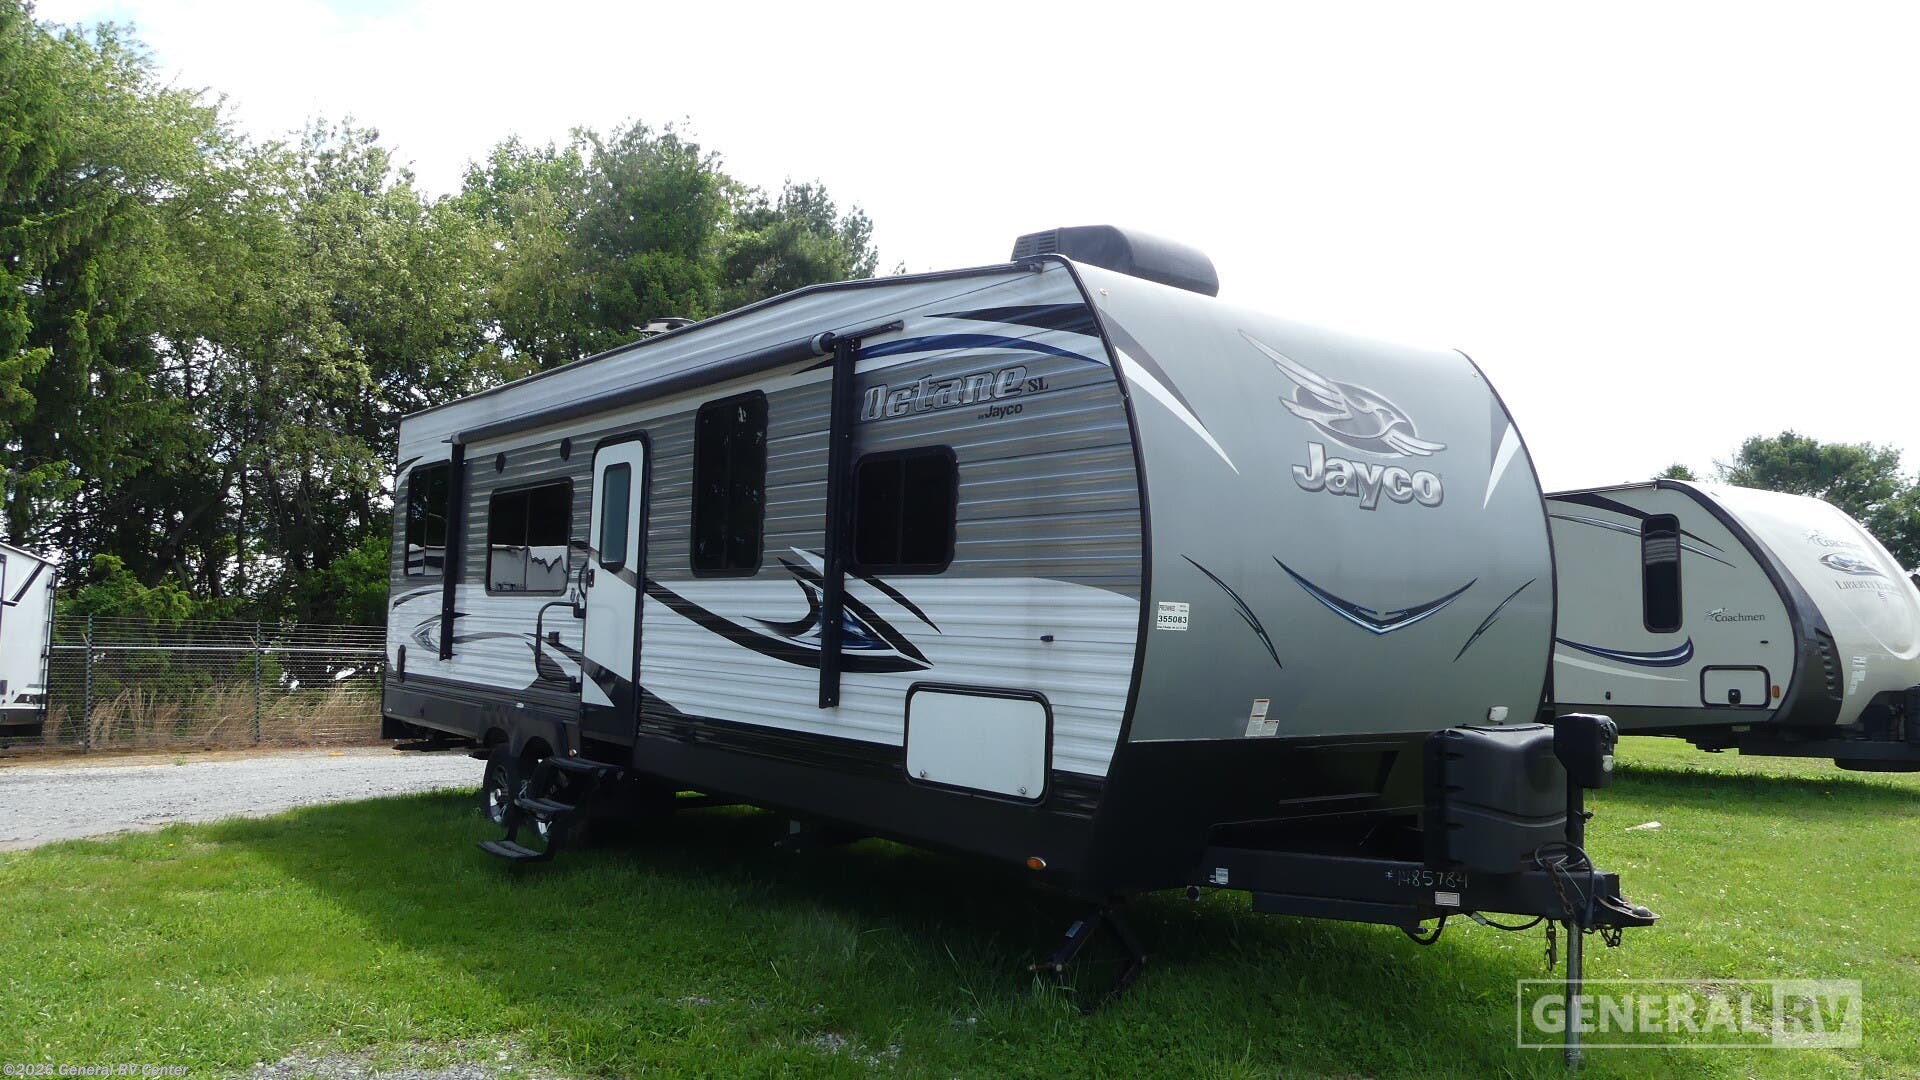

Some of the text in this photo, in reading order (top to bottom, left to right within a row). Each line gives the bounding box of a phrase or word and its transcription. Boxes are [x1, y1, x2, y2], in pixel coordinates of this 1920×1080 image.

[861, 366, 1049, 421] Octane SL
[985, 403, 1023, 420] Jayco
[1292, 441, 1444, 511] Jayco
[1714, 612, 1766, 623] Coachmen
